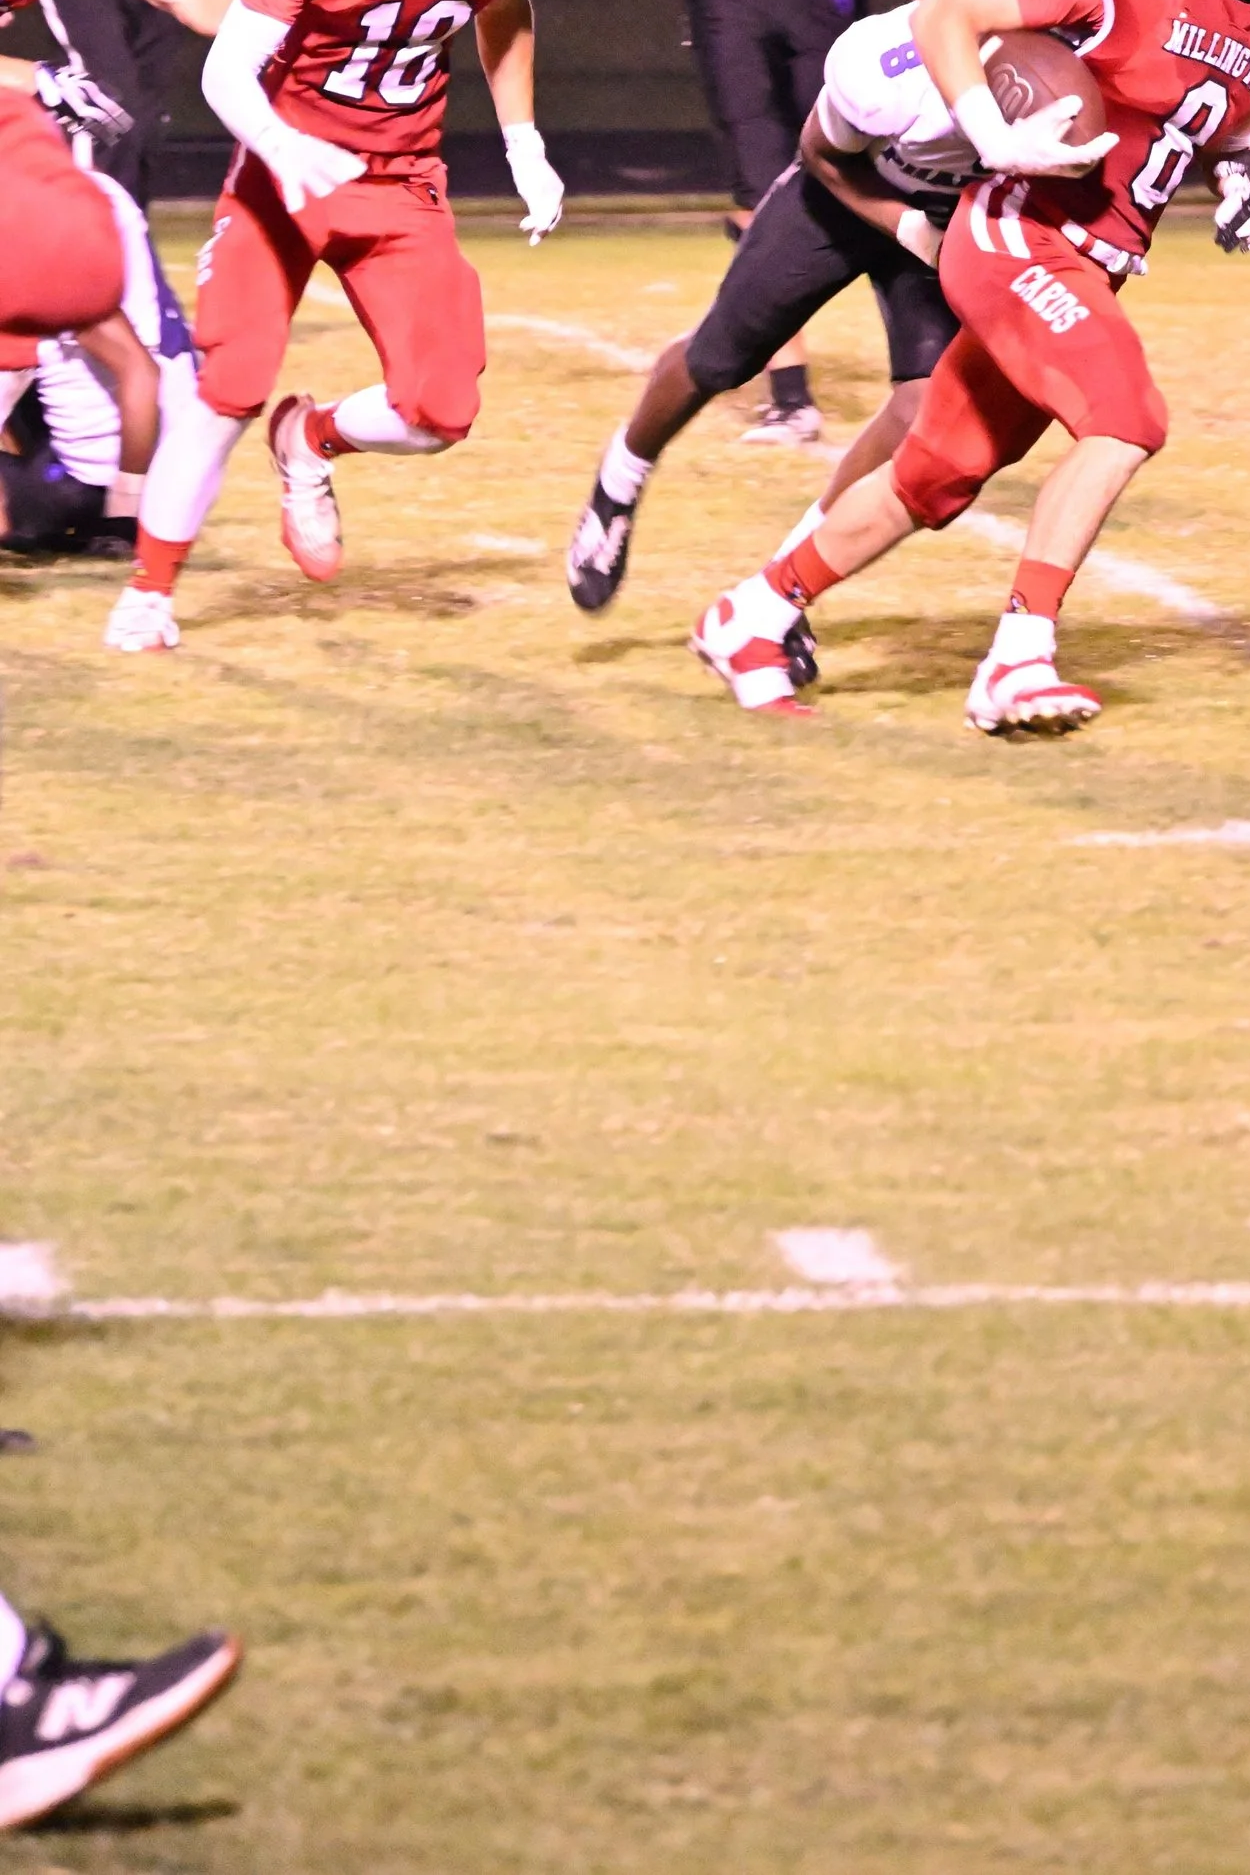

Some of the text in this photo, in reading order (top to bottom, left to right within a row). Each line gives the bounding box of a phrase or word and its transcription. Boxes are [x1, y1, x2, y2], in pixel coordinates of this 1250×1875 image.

[322, 0, 474, 105] 18
[1131, 79, 1229, 210] 8
[1009, 264, 1091, 334] CARDS
